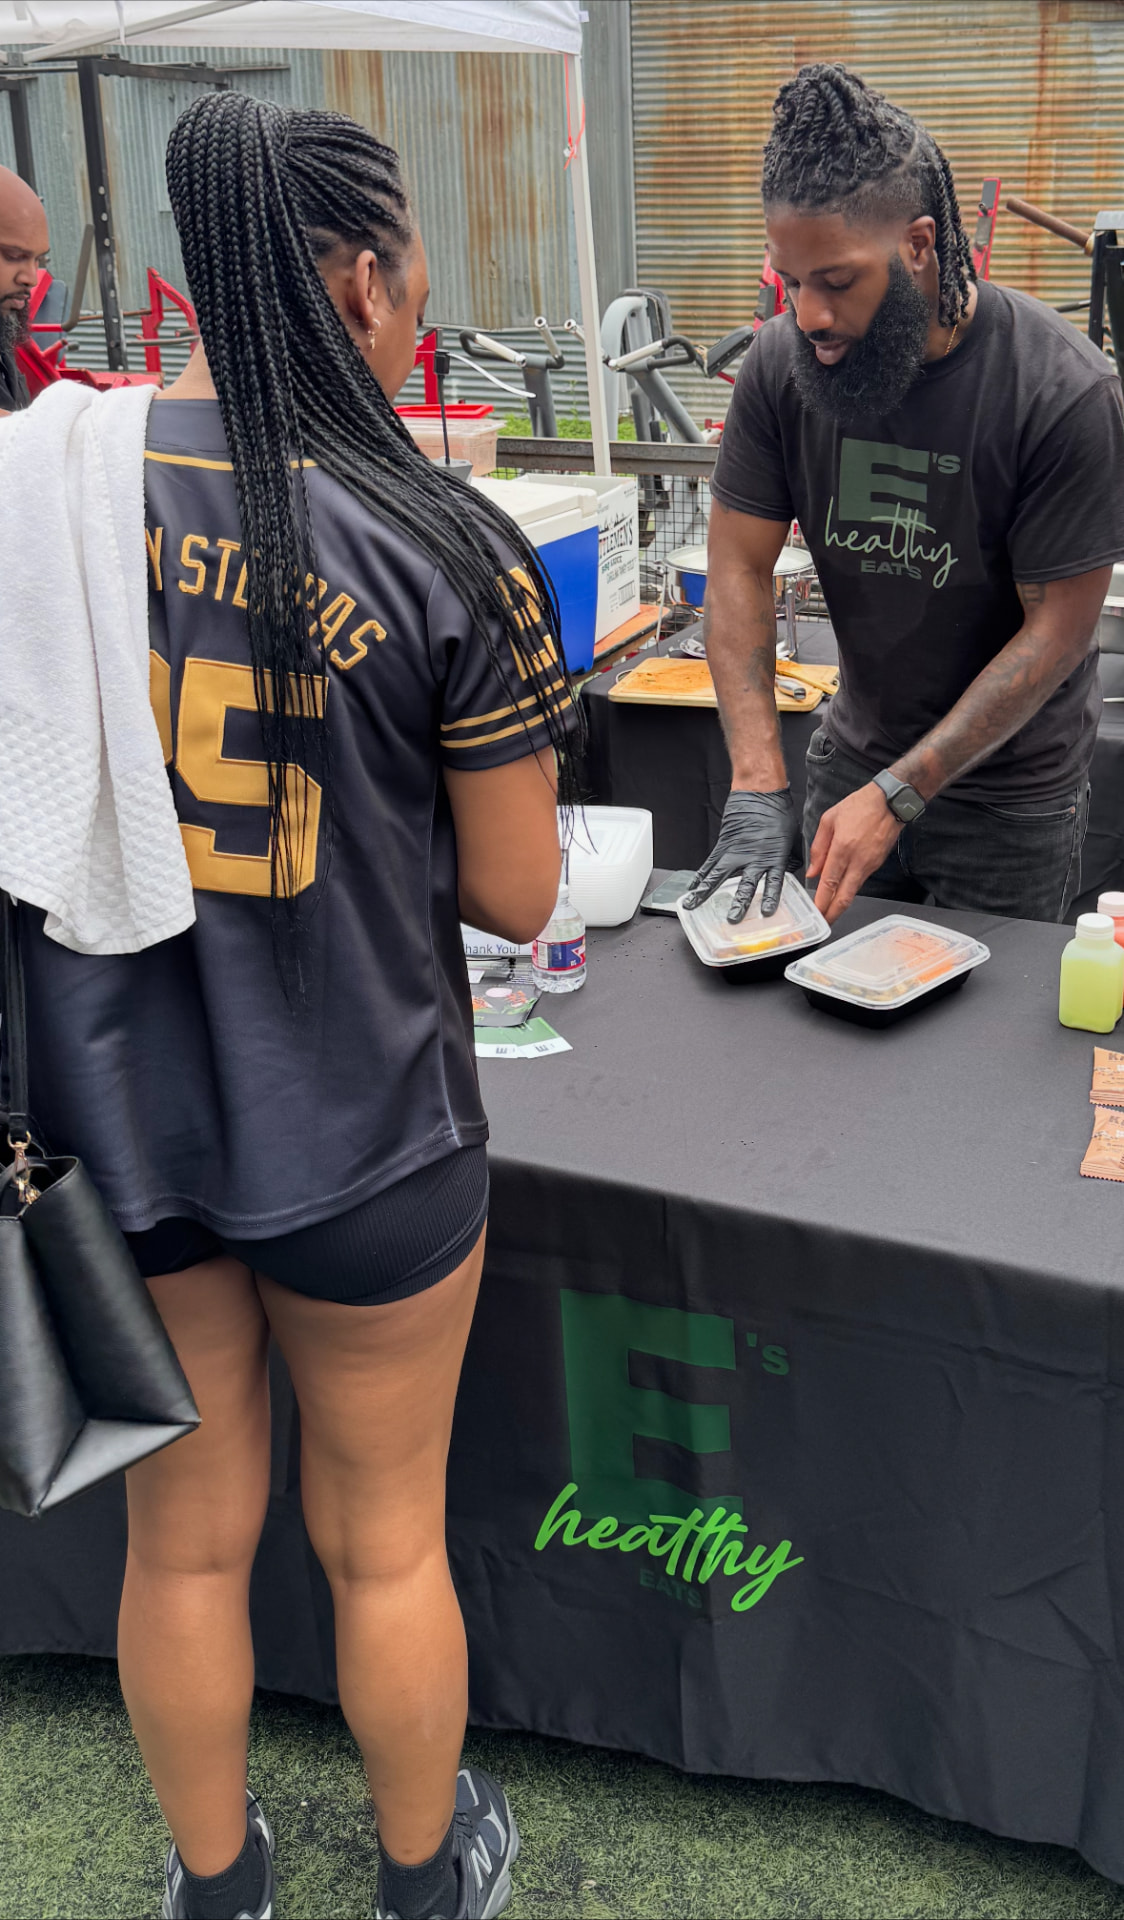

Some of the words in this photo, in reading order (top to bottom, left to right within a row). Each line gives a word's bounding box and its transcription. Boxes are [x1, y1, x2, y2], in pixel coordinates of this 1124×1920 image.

[860, 559, 922, 580] EATS
[465, 943, 493, 954] hank
[496, 943, 521, 955] You!
[534, 1482, 804, 1612] healthy
